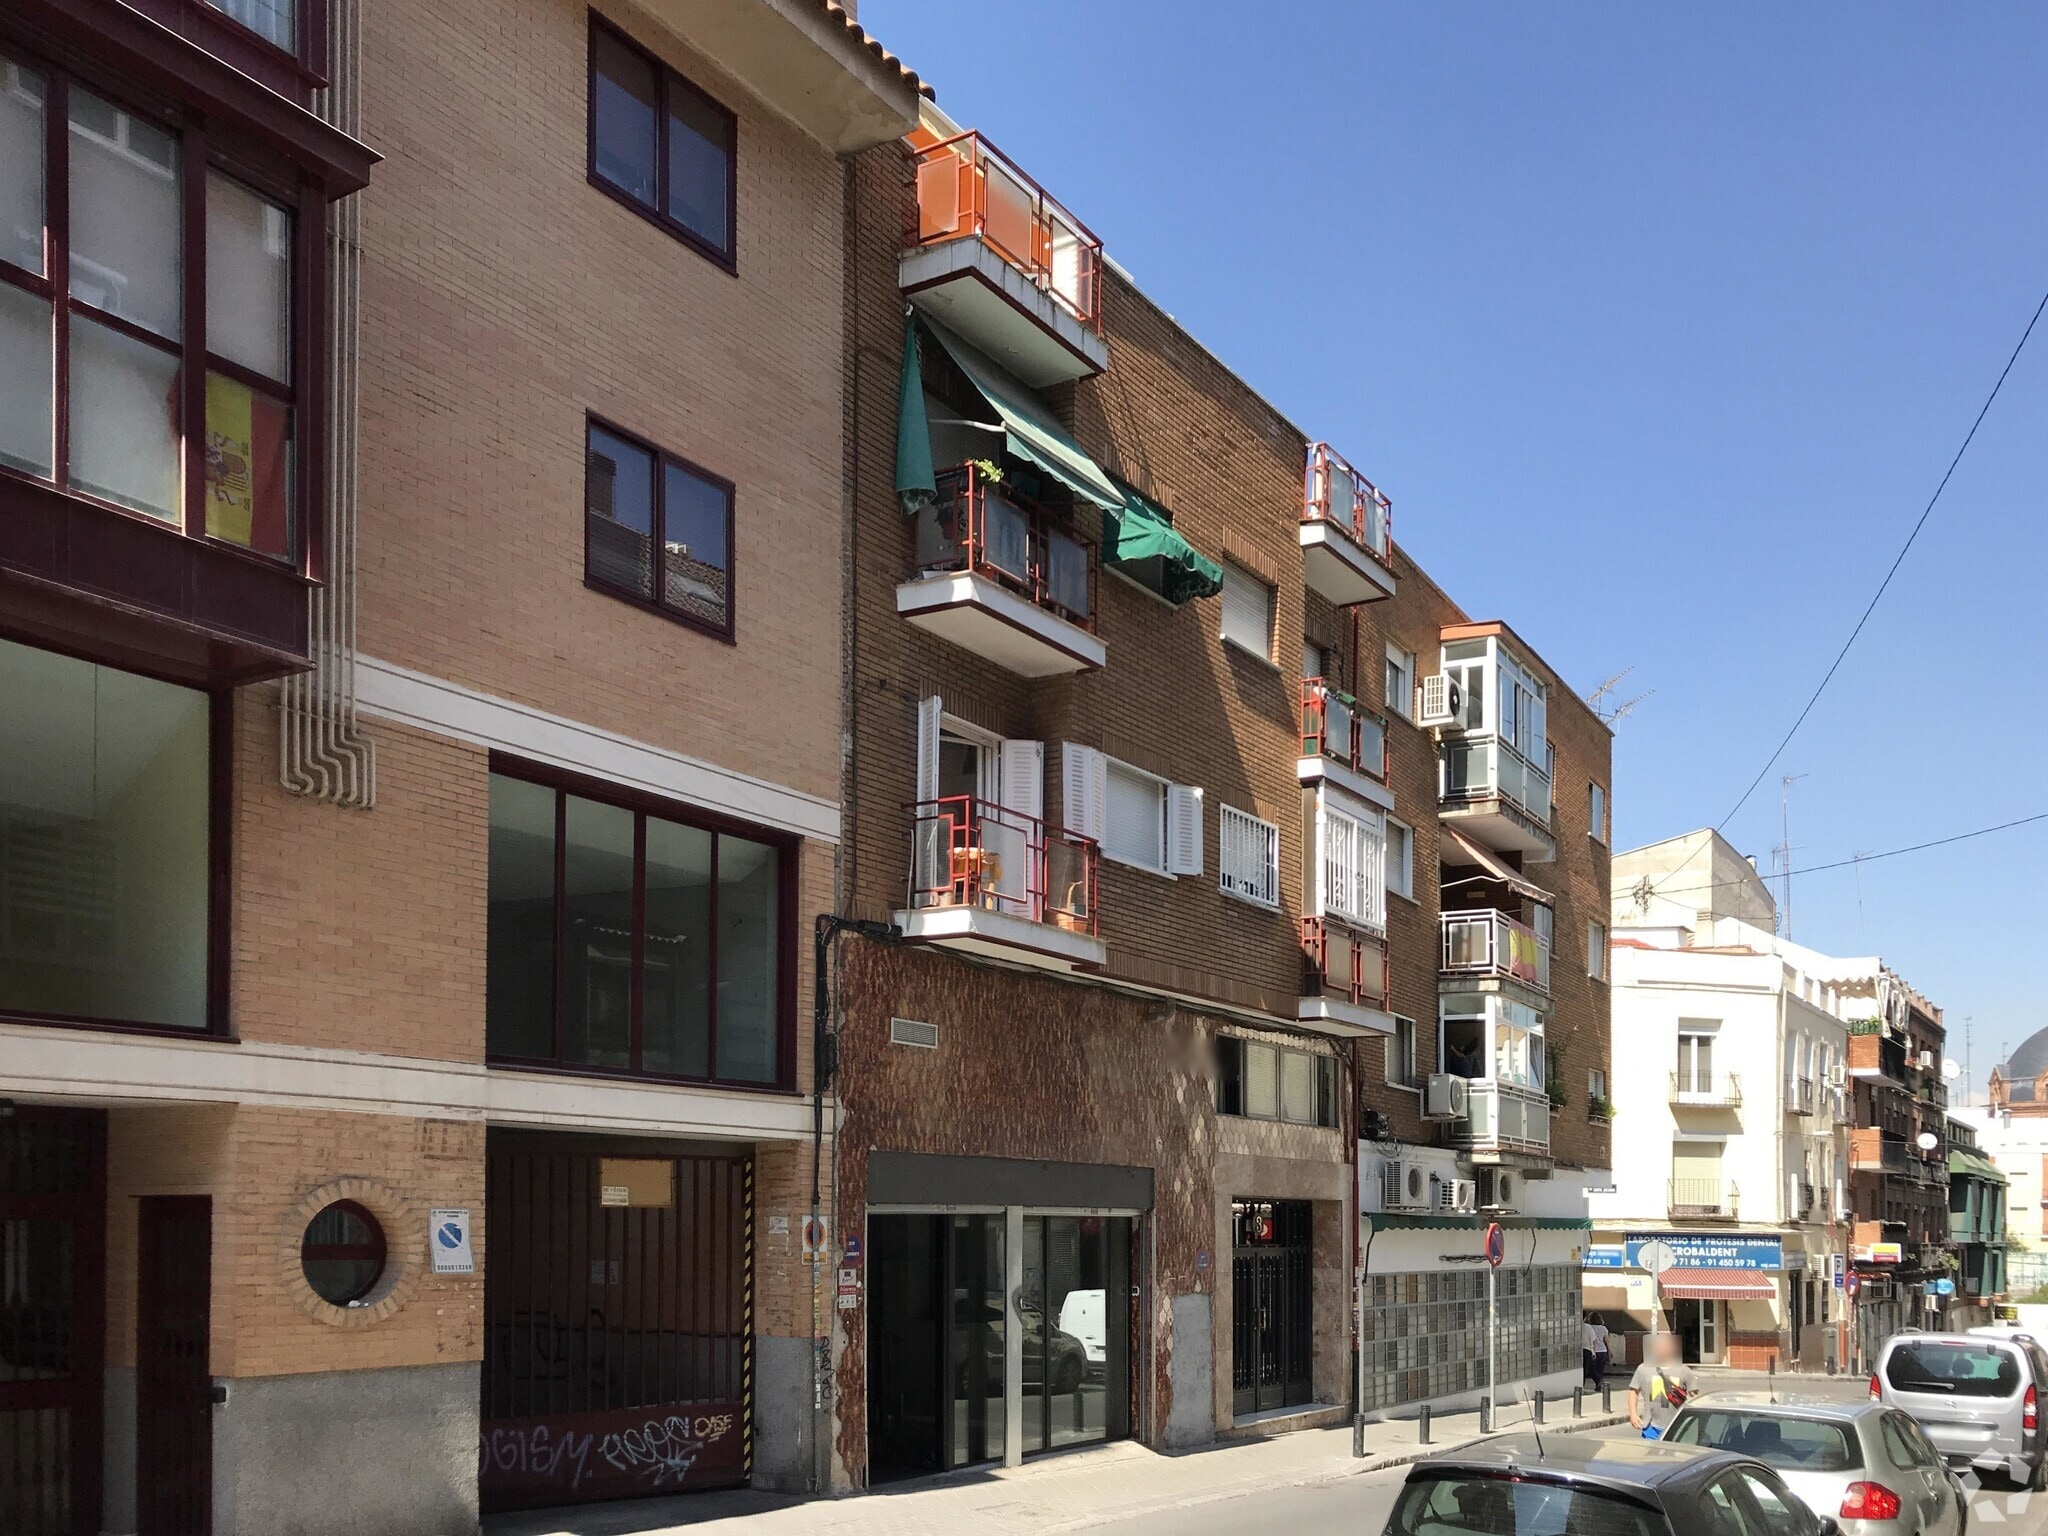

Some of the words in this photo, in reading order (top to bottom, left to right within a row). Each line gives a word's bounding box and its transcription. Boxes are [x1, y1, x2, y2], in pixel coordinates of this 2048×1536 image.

[1256, 1216, 1262, 1232] 3
[1691, 1237, 1702, 1245] DE
[1705, 1237, 1745, 1246] PROTESIS
[1747, 1238, 1779, 1247] DENTAL
[1679, 1258, 1688, 1266] 71
[1690, 1258, 1701, 1266] 86
[1707, 1258, 1717, 1267] 91
[1718, 1259, 1734, 1267] 450
[1735, 1259, 1745, 1267] 59
[1746, 1259, 1756, 1267] 78
